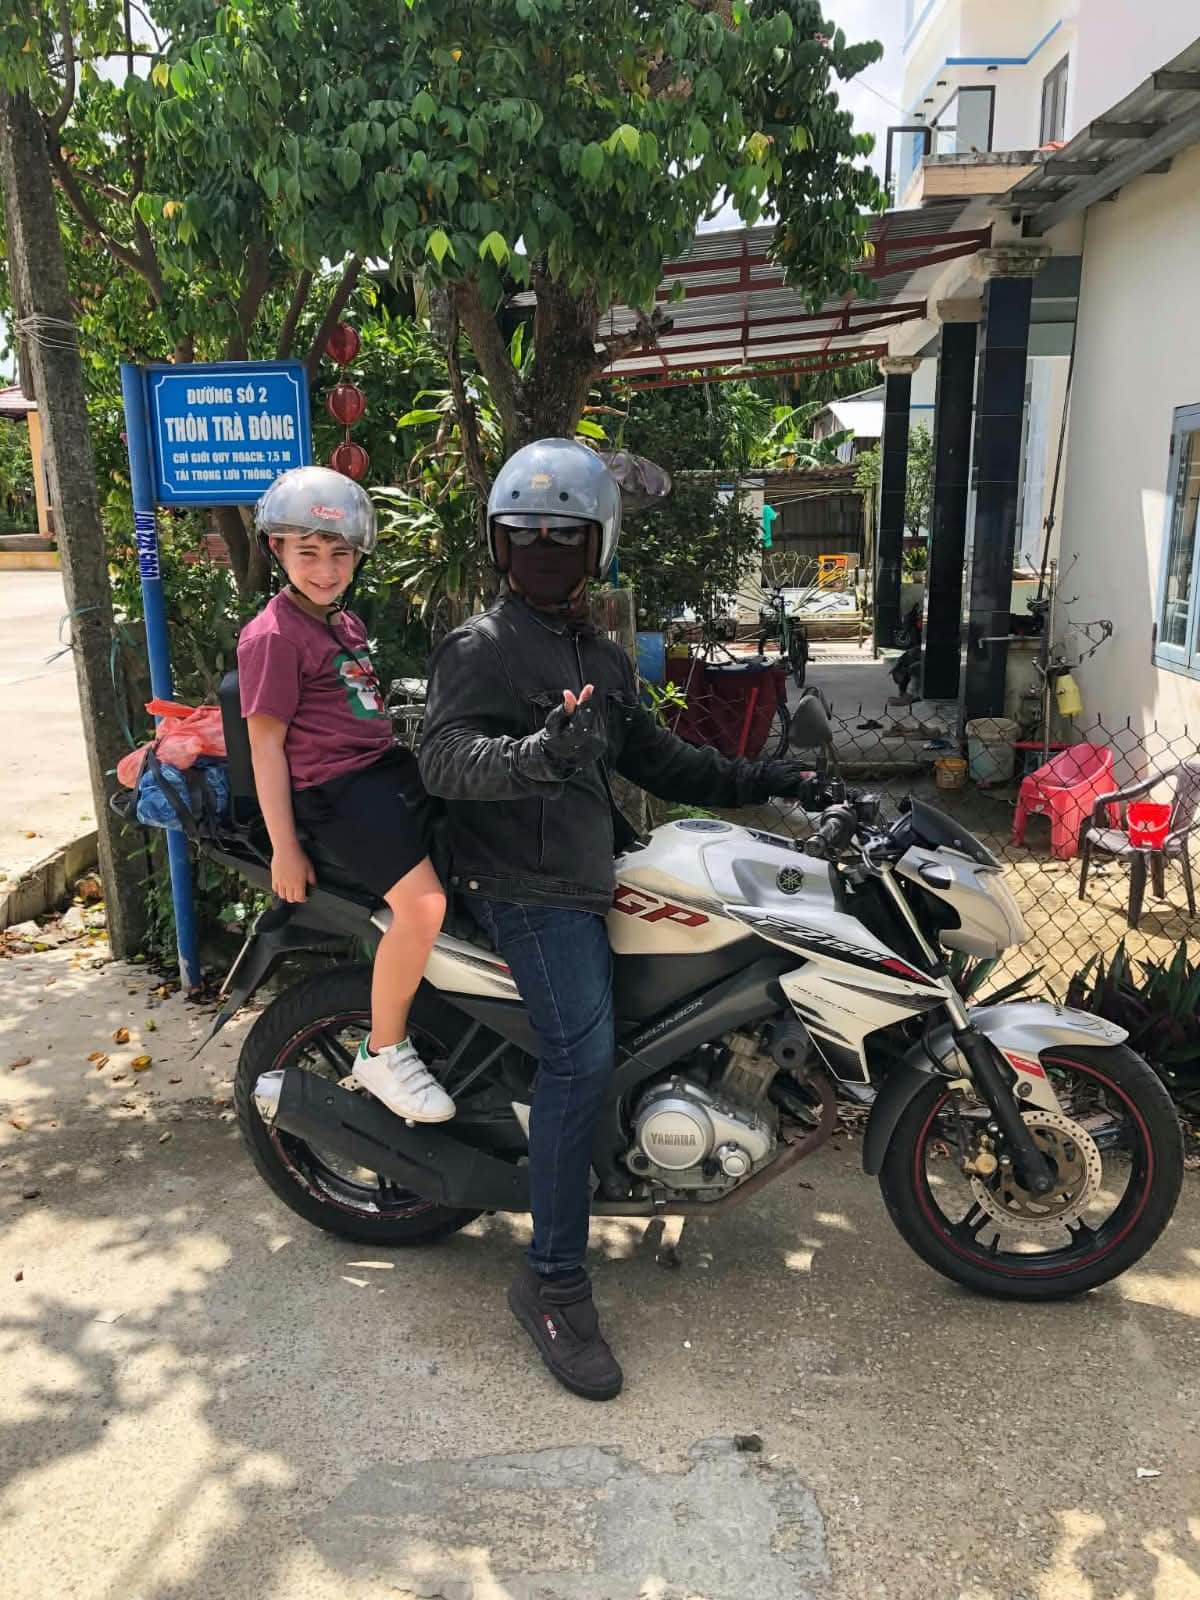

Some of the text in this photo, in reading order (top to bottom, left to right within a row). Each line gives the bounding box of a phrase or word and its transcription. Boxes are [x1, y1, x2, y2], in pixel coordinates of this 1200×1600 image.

[236, 382, 255, 404] SỐ
[258, 386, 268, 403] 2
[164, 410, 295, 442] THÔN TRÀ ĐÔNG
[212, 451, 230, 464] QUY
[191, 469, 222, 482] TRỌNG
[612, 883, 711, 928] GP
[751, 915, 892, 962] FZ150i
[650, 1132, 697, 1146] YAMAHA
